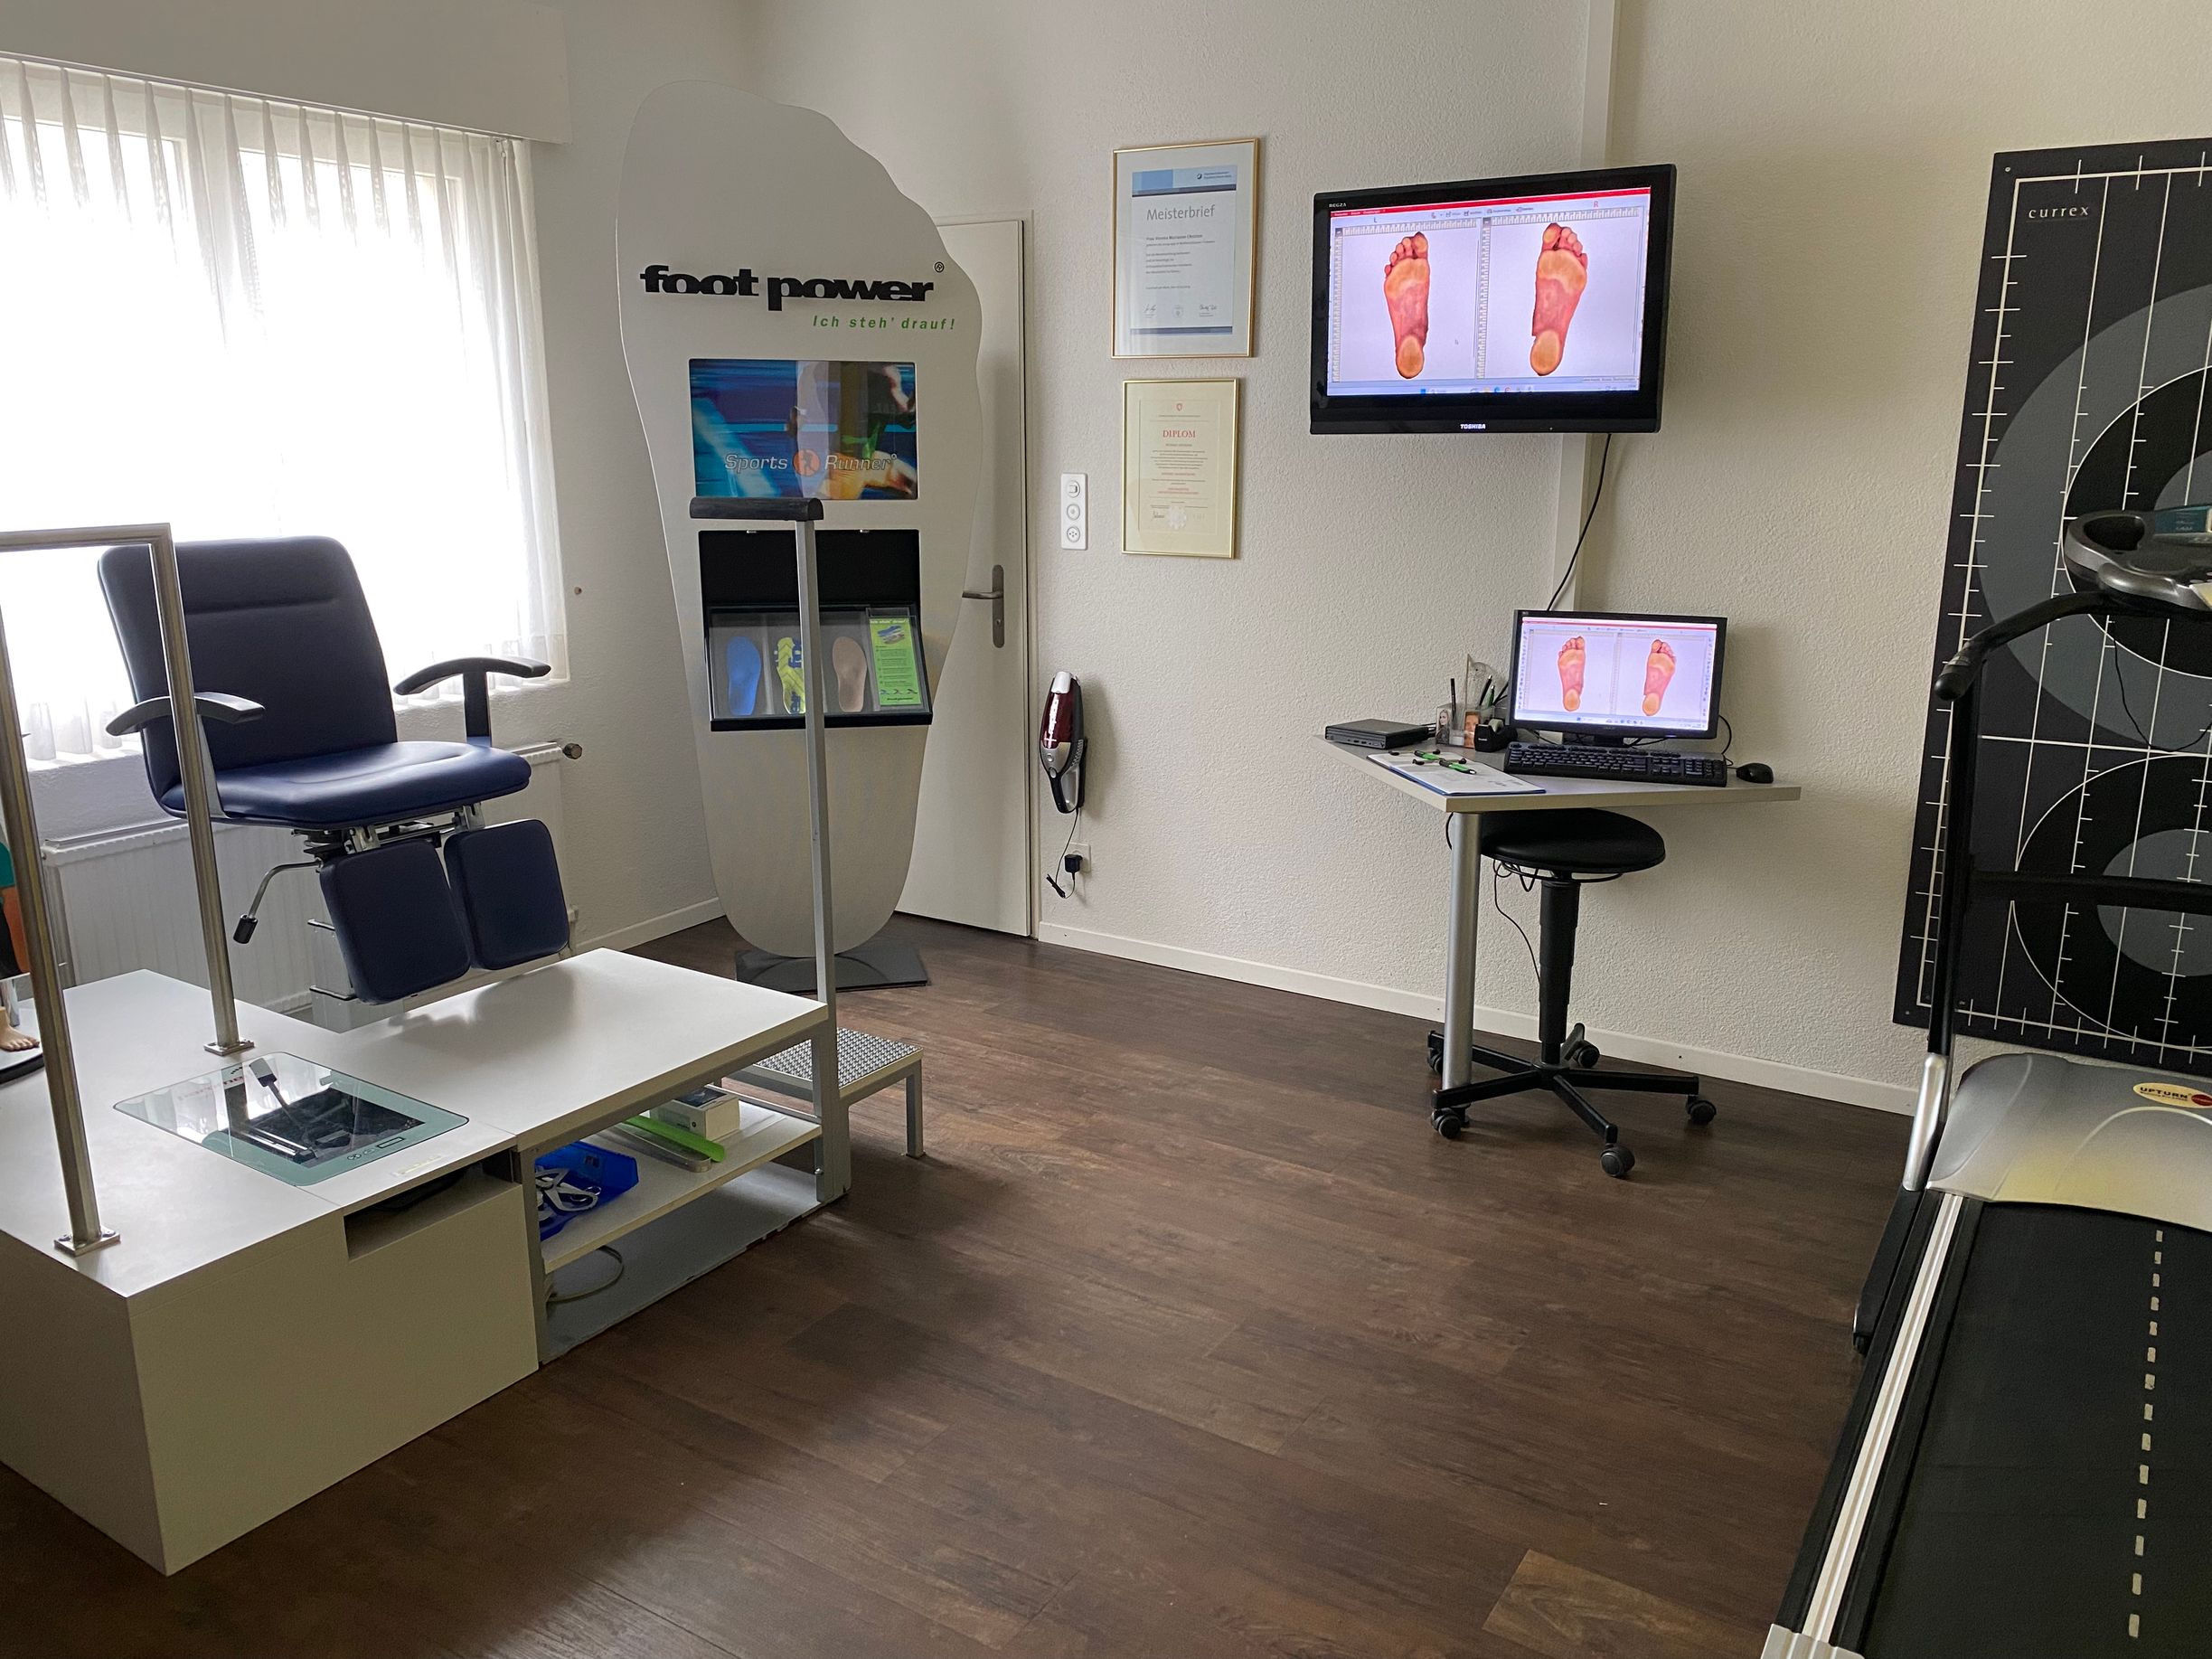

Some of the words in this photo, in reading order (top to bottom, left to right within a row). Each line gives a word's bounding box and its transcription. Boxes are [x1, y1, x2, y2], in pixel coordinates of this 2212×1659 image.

[1146, 204, 1216, 222] Meisterbrief
[2028, 205, 2089, 219] currex
[640, 264, 759, 297] foot
[767, 276, 935, 312] power
[812, 316, 840, 328] Ich
[849, 316, 895, 329] steh'
[901, 317, 955, 331] drauf!
[1162, 429, 1196, 438] DIPLOM
[724, 454, 789, 471] Sports
[2140, 1087, 2188, 1099] UPTURN
